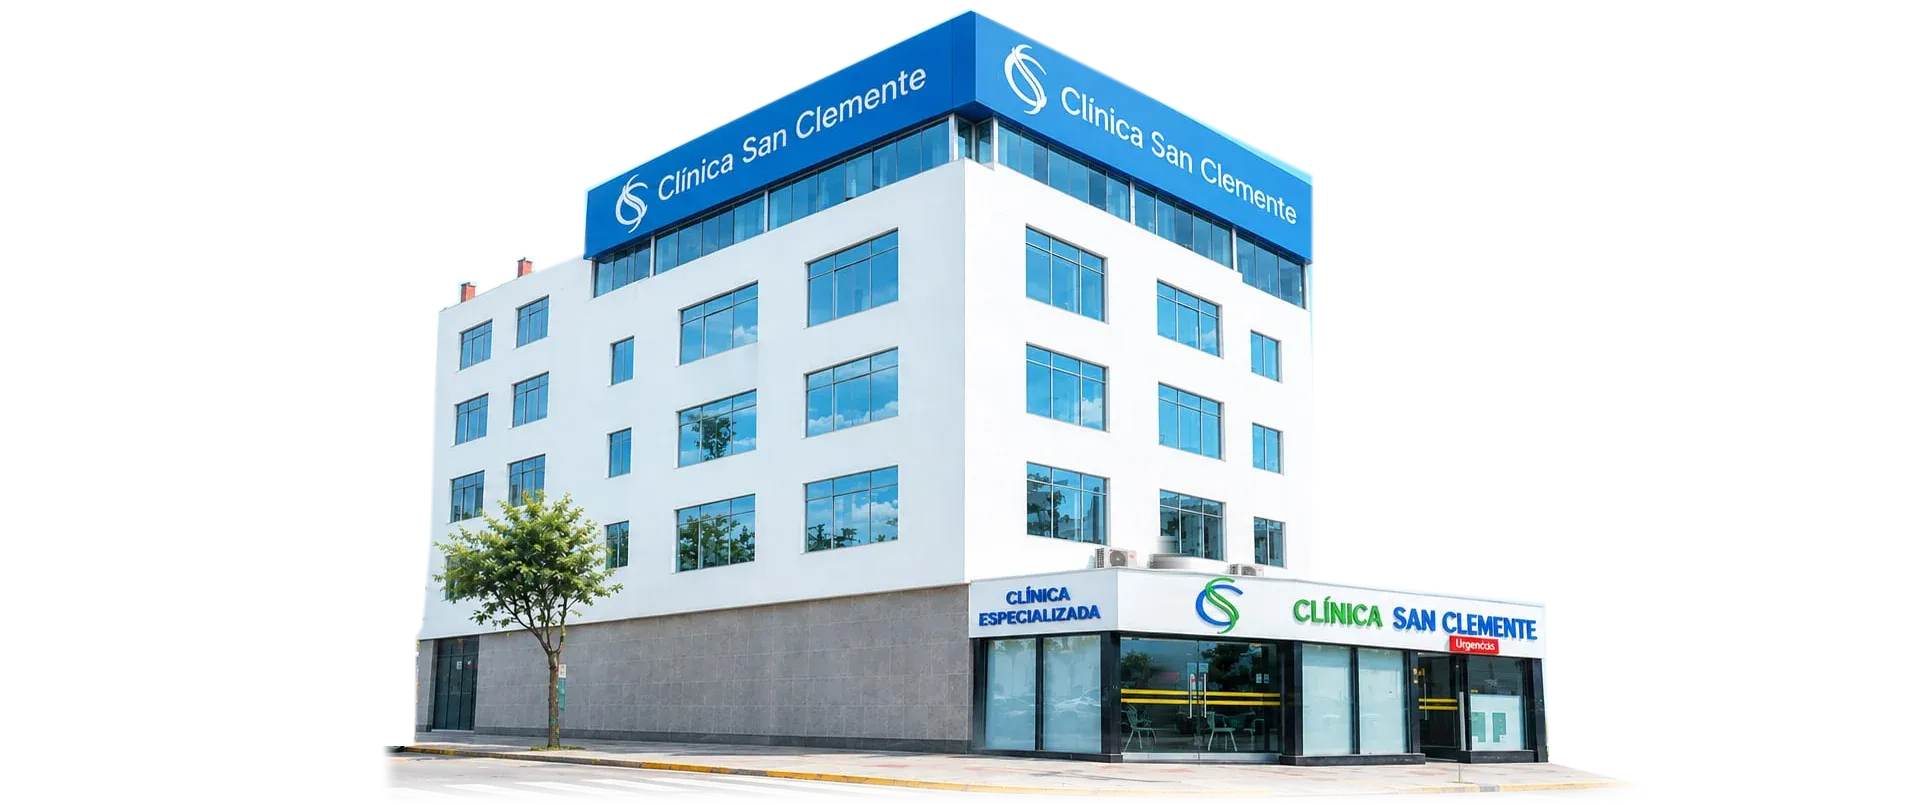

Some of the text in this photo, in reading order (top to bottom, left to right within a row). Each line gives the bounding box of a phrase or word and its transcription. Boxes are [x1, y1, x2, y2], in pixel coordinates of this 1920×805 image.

[658, 67, 927, 201] Clínica San Clemente
[1061, 86, 1298, 226] Clínica San Clemente
[978, 605, 1101, 627] ESPECIALIZADA
[1006, 586, 1071, 605] CLÍNICA
[1293, 596, 1538, 641] CLÍNICA SAN CLEMENTE
